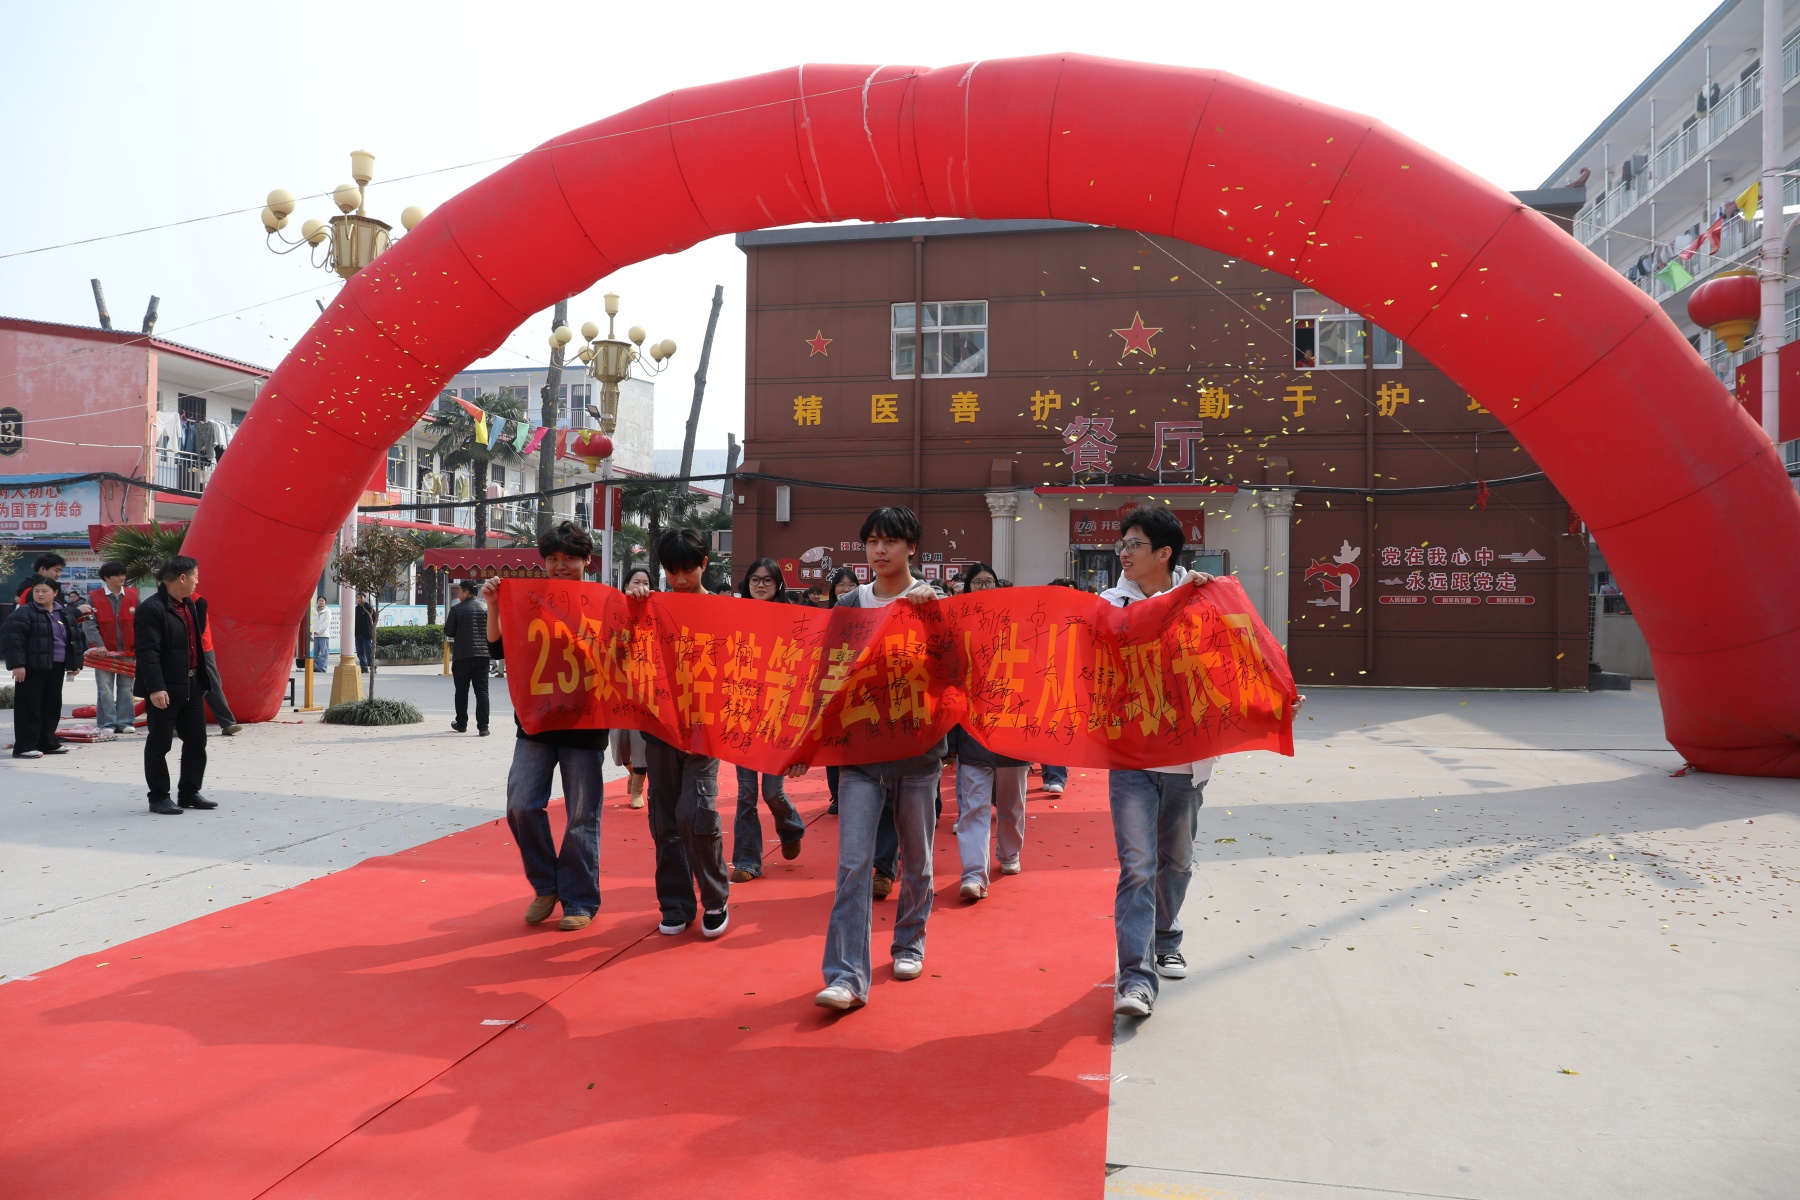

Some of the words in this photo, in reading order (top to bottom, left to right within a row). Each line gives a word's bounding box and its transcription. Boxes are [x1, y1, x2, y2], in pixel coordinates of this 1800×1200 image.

[793, 389, 1062, 426] 精医善护
[1199, 383, 1490, 420] 勤于护
[1061, 416, 1204, 474] 餐厅
[0, 501, 82, 518] 为国育才使命
[922, 552, 943, 562] 作用
[1382, 547, 1494, 566] 党在我心中
[802, 569, 821, 578] 党建
[1406, 572, 1516, 591] 永远跟党走
